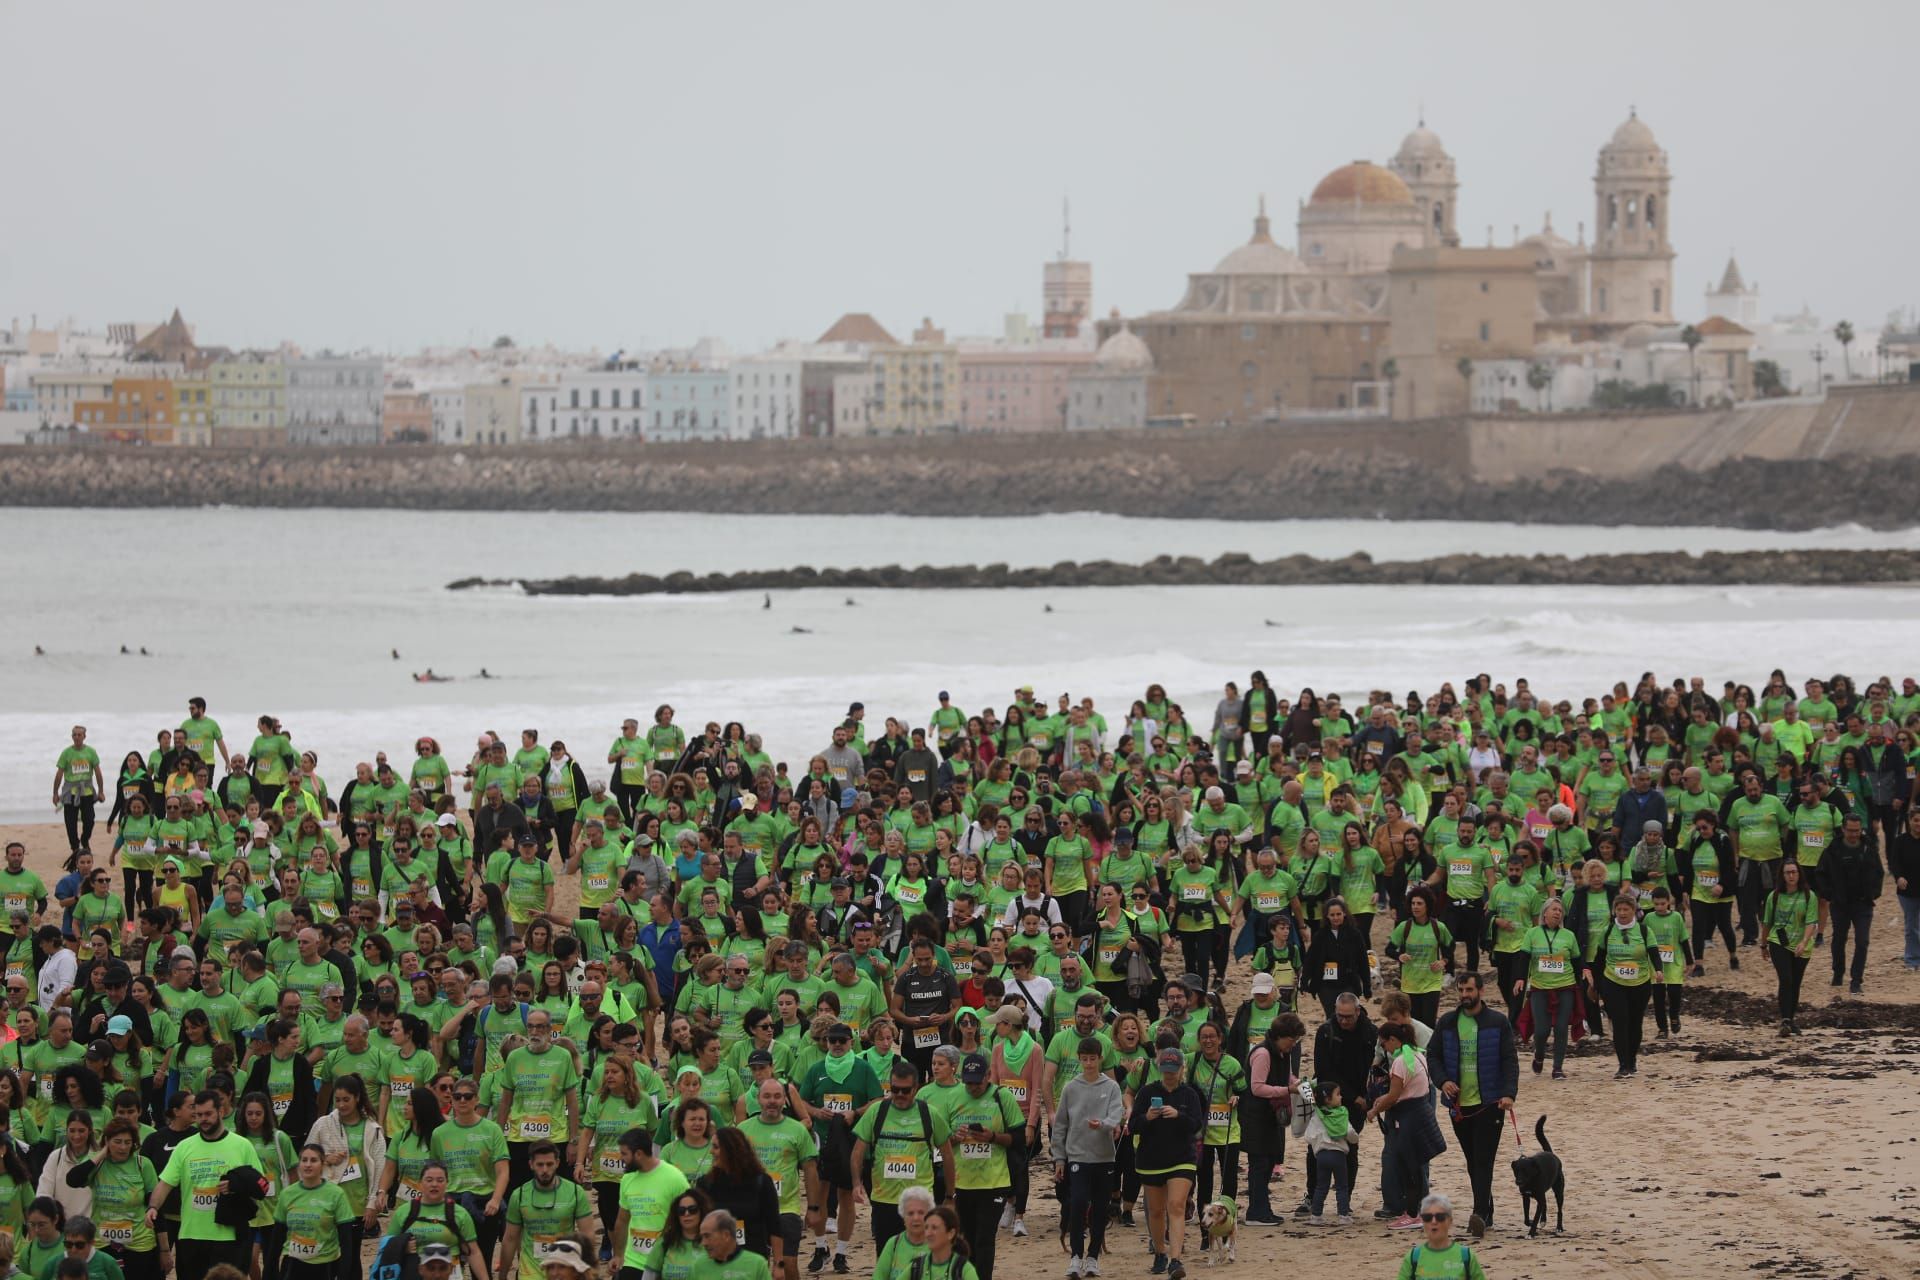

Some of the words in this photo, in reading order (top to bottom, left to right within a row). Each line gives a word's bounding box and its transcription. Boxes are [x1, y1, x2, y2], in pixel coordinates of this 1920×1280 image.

[1452, 864, 1471, 872] 2852
[591, 879, 608, 887] 1585
[918, 1032, 939, 1043] 1299
[393, 1082, 412, 1091] 2254
[827, 1101, 851, 1111] 4781
[523, 1122, 549, 1133] 4309
[963, 1143, 990, 1153] 3752
[887, 1162, 914, 1173] 4040
[103, 1229, 131, 1240] 4005
[292, 1243, 315, 1254] 1147
